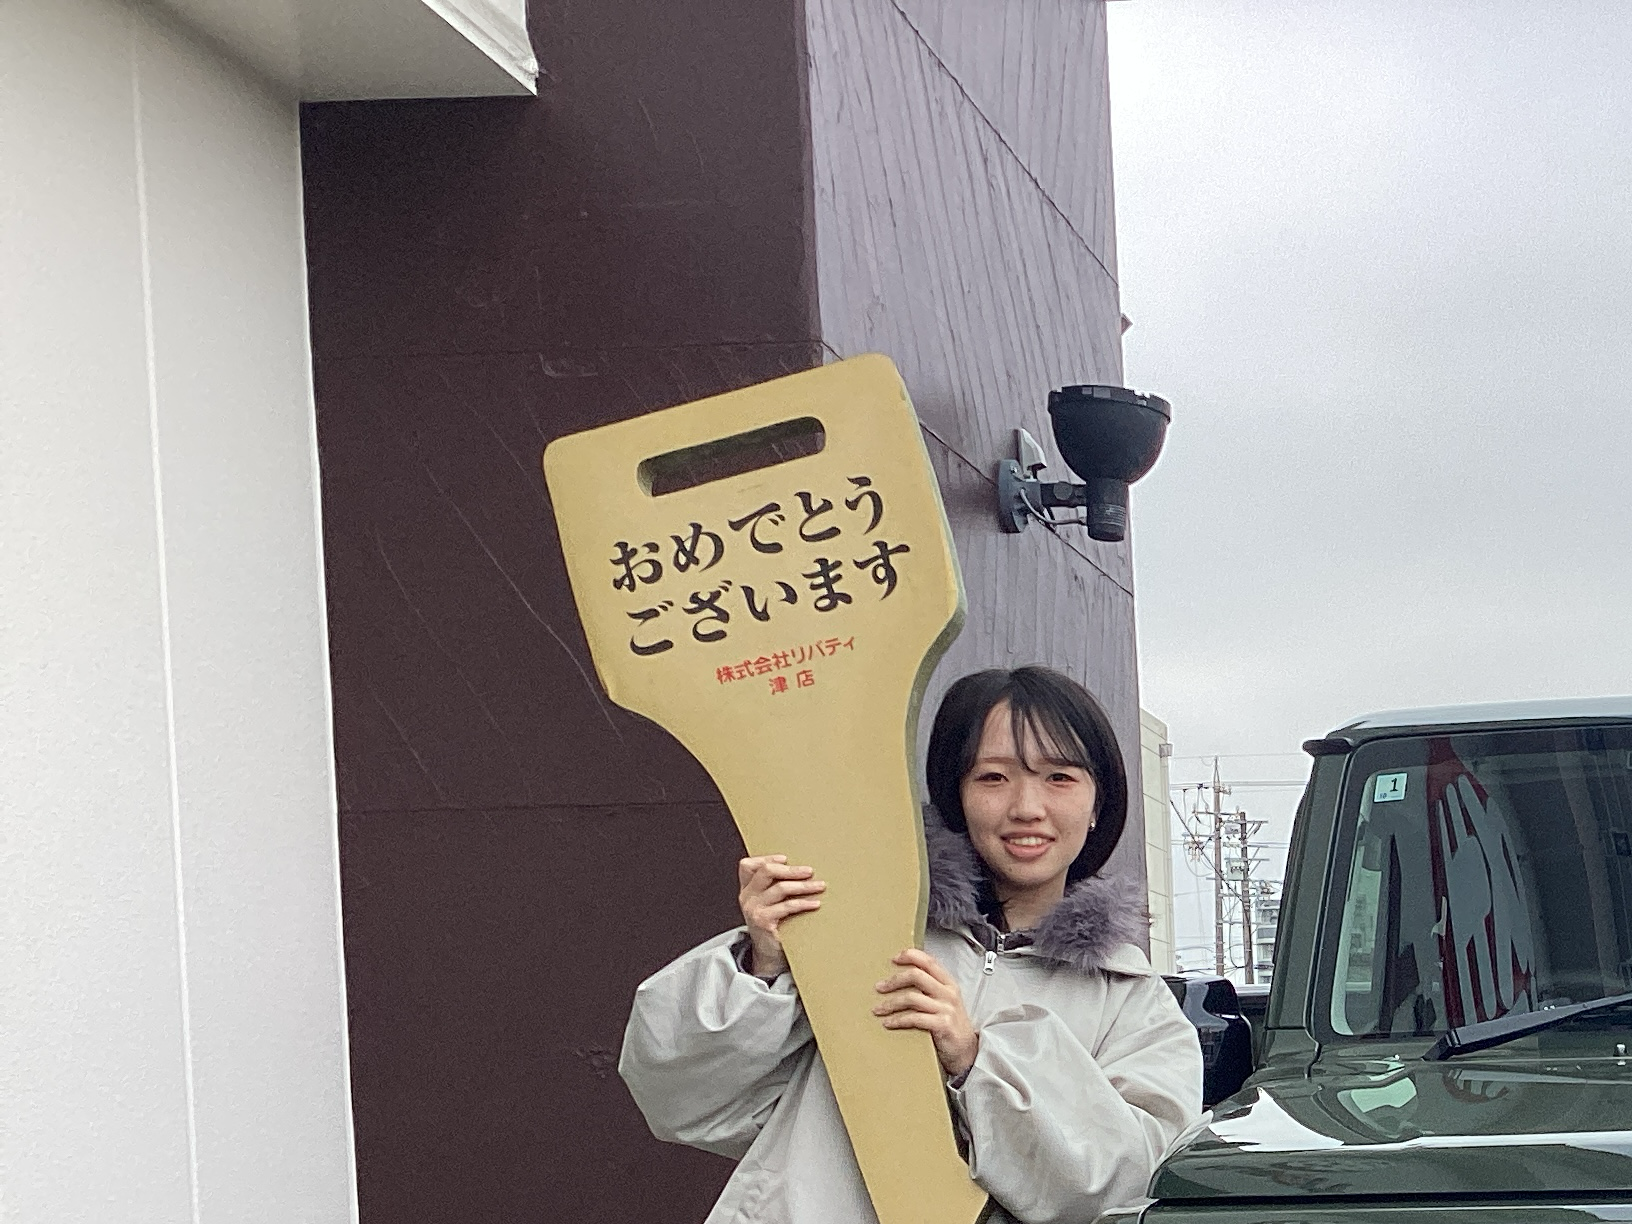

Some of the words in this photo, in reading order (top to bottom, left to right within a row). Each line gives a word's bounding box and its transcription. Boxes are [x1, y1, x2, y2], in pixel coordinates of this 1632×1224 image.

[609, 476, 884, 593] おめでとう
[626, 540, 911, 656] ございます
[715, 636, 856, 686] 株式会社リバティ
